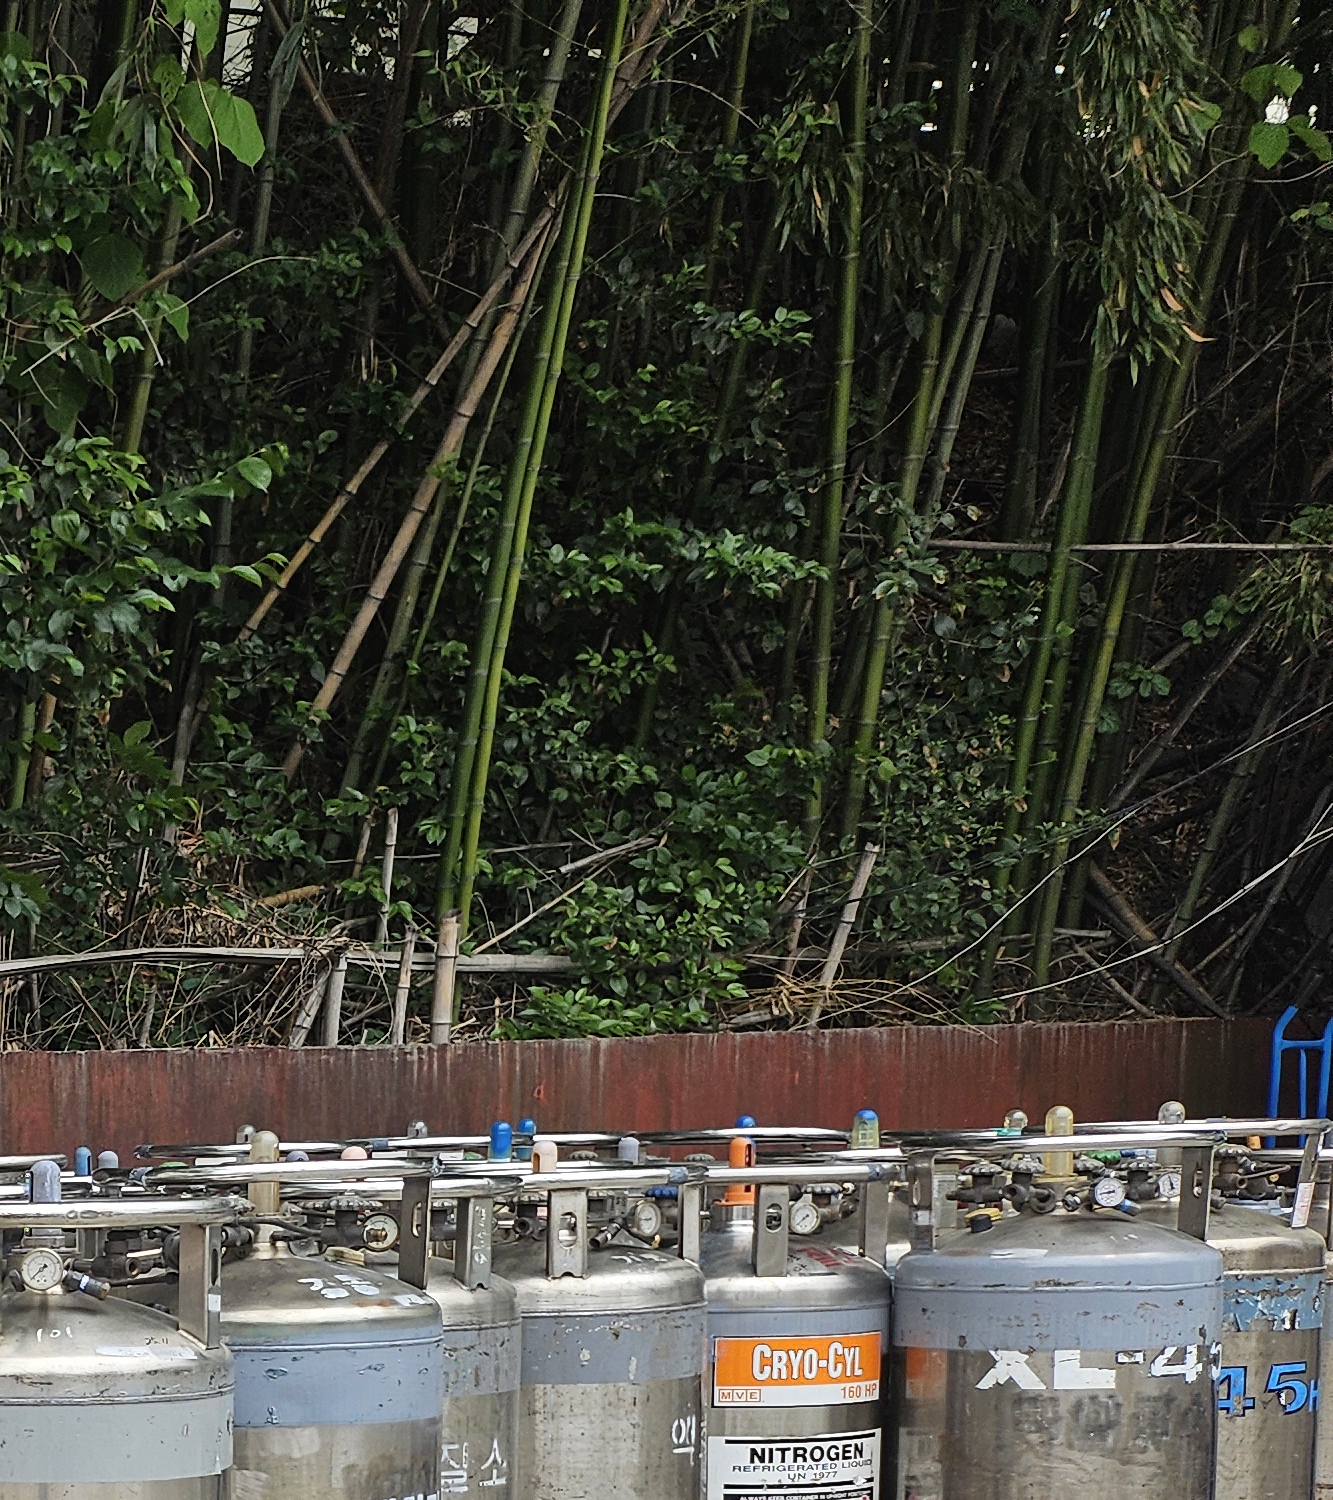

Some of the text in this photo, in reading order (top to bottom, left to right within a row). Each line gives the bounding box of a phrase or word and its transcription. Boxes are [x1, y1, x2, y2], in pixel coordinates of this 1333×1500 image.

[720, 1391, 759, 1400] MVE
[840, 1384, 877, 1399] 160 HP
[749, 1442, 864, 1464] NITROGEN
[732, 1459, 872, 1473] REFRIGERATED LIQUID
[813, 1471, 838, 1480] 1977
